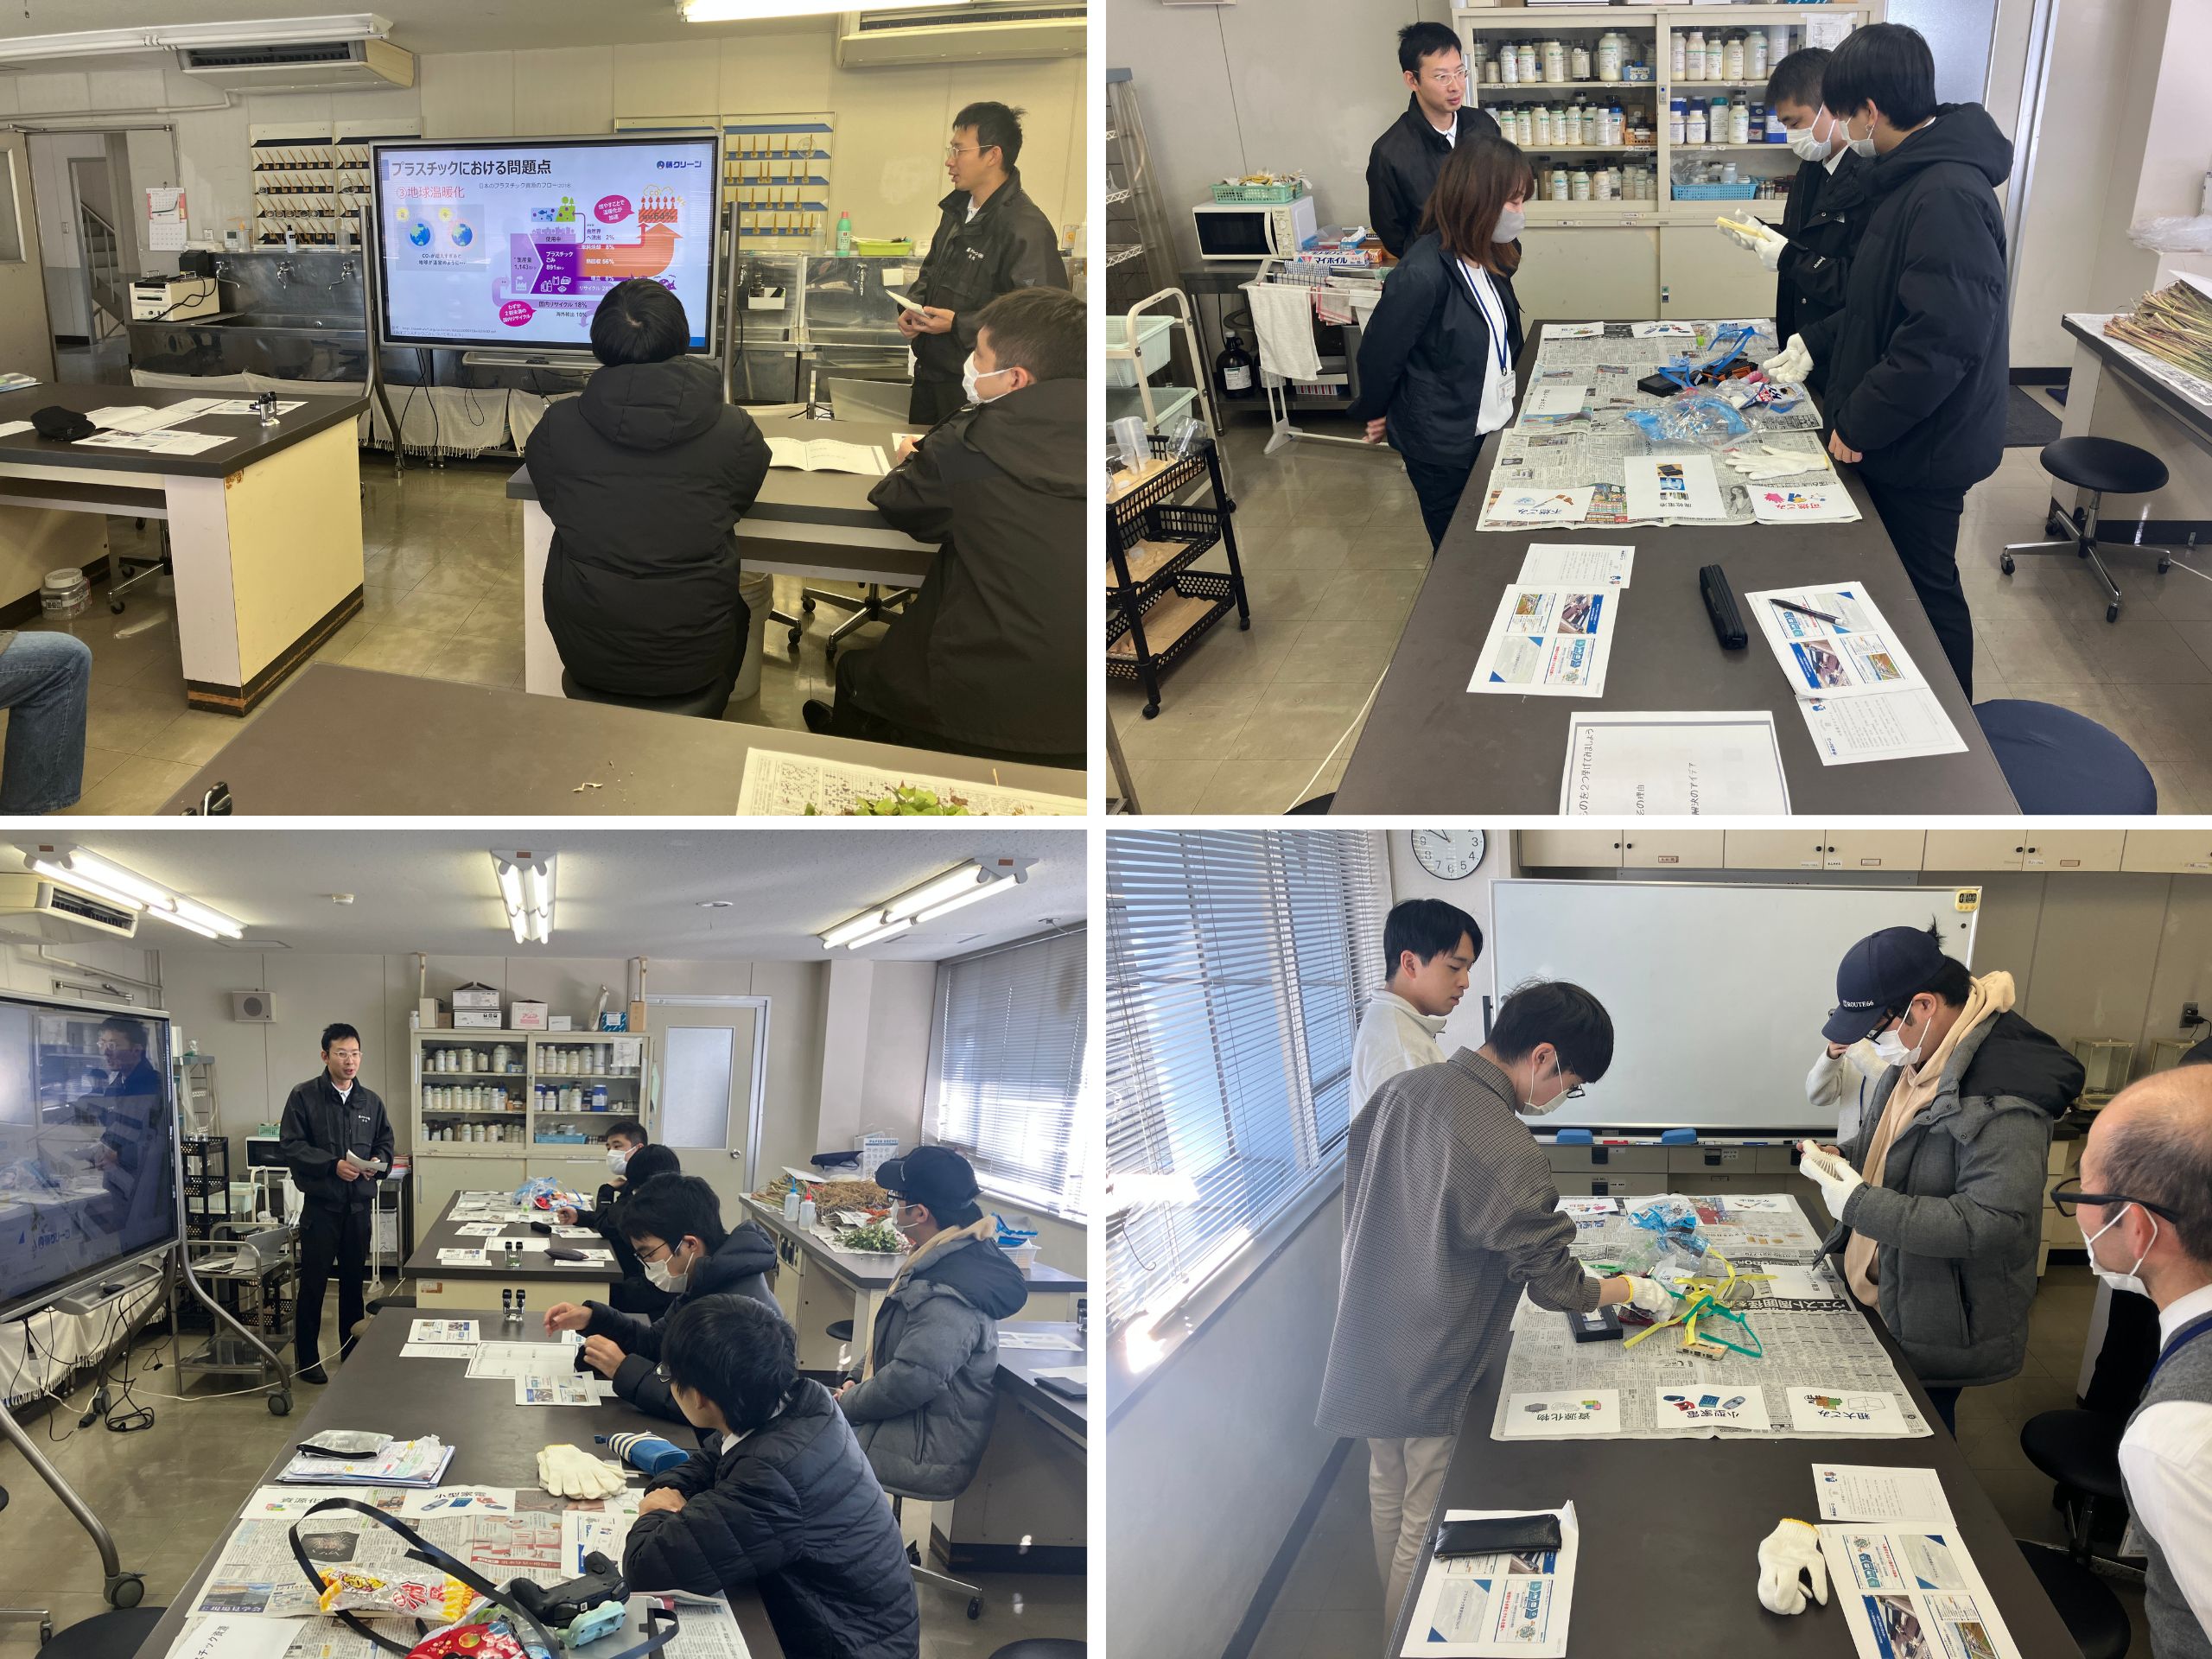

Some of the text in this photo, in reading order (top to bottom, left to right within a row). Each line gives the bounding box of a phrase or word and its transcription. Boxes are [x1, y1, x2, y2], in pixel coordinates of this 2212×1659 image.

[391, 160, 551, 176] プラスチックにおける問題点
[396, 186, 465, 200] ③地球温暖化
[1516, 507, 1563, 516] 不燃ごみ
[1420, 836, 1427, 845] 9
[1471, 836, 1478, 847] 3
[1425, 850, 1432, 860] 8
[1468, 851, 1475, 861] 4
[1435, 860, 1441, 869] 7
[1447, 863, 1454, 874] 6
[1460, 860, 1467, 870] 5
[1537, 1412, 1591, 1422] 資源化物
[1687, 1408, 1739, 1419] 小型家電
[1817, 1409, 1871, 1421] 粗大ごみ
[435, 1491, 487, 1499] 小型家電
